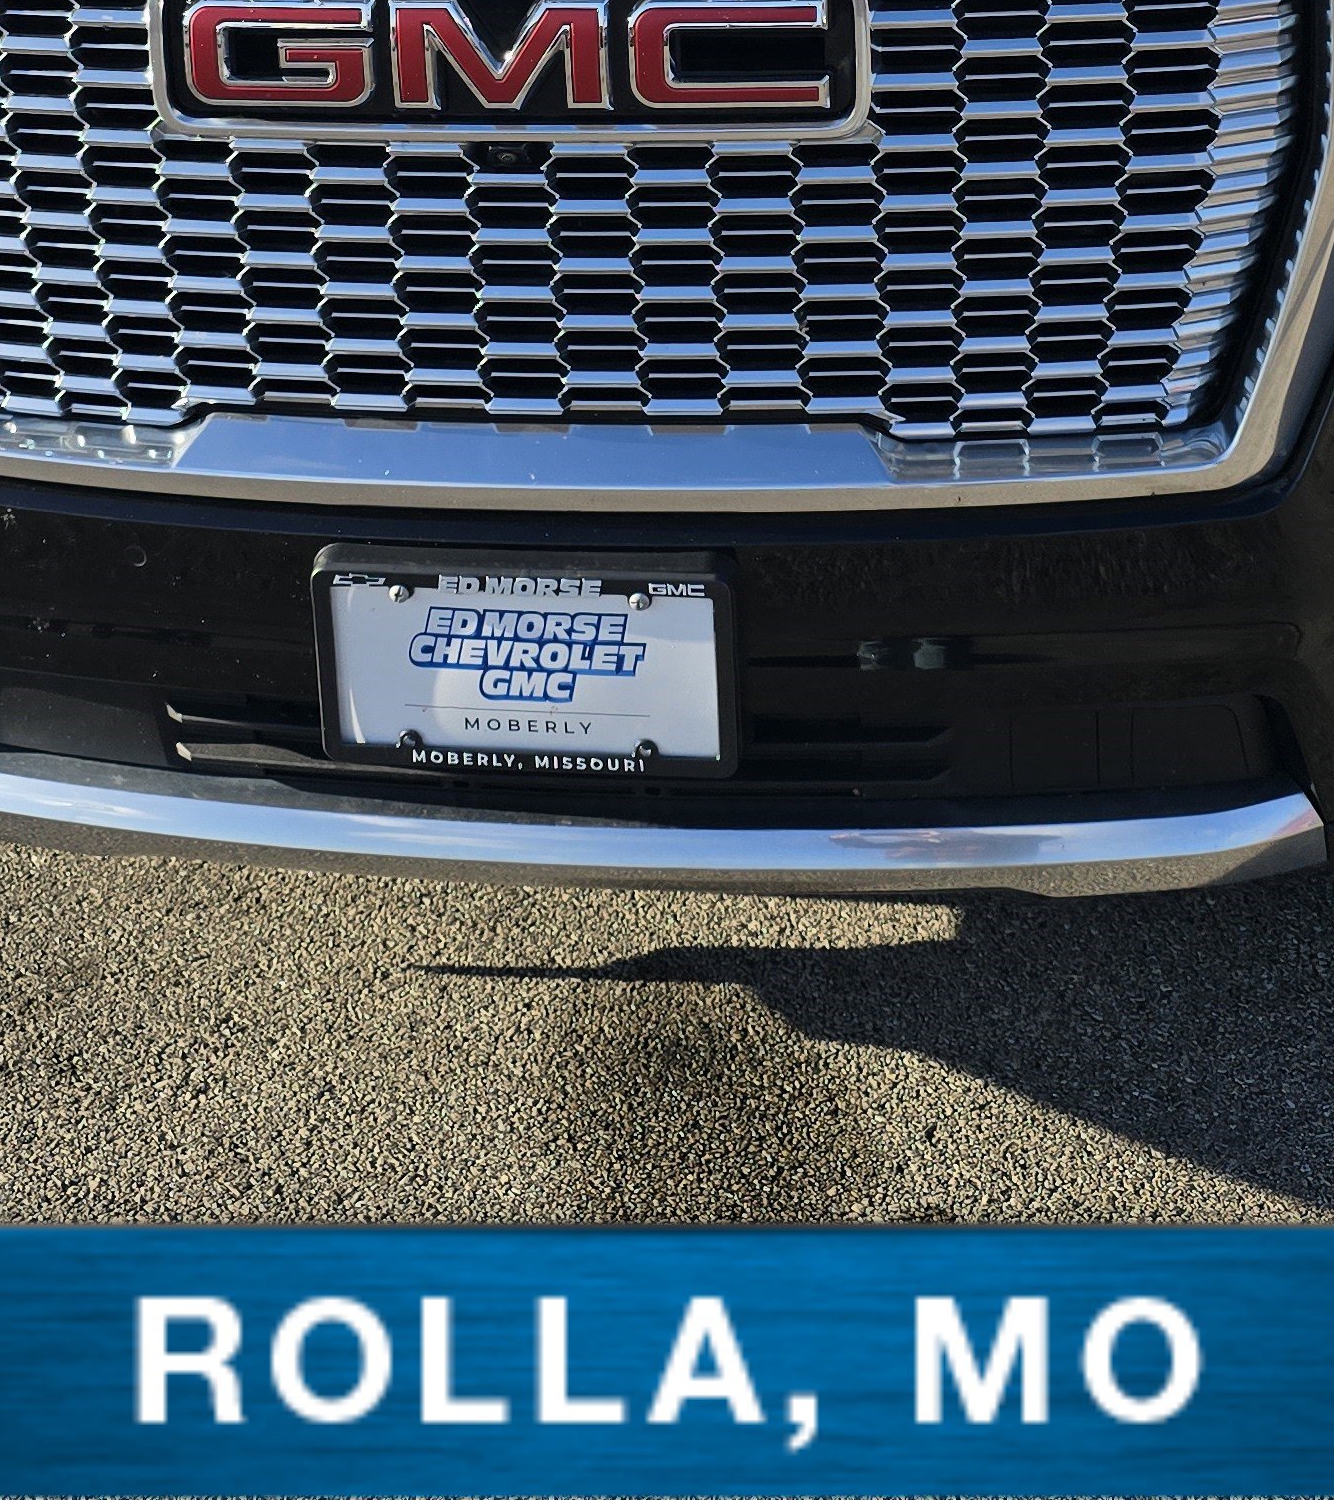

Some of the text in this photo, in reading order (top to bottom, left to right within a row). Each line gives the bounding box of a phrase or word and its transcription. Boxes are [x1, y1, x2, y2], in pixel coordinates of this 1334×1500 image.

[438, 575, 603, 598] ED MORSE
[648, 583, 705, 597] GMC
[426, 608, 627, 641] ED MORSE
[410, 635, 645, 673] CHEVROLET
[479, 669, 576, 701] GMC
[464, 717, 593, 734] MOBERLY
[412, 749, 646, 772] MOBERLY, MISSOURI
